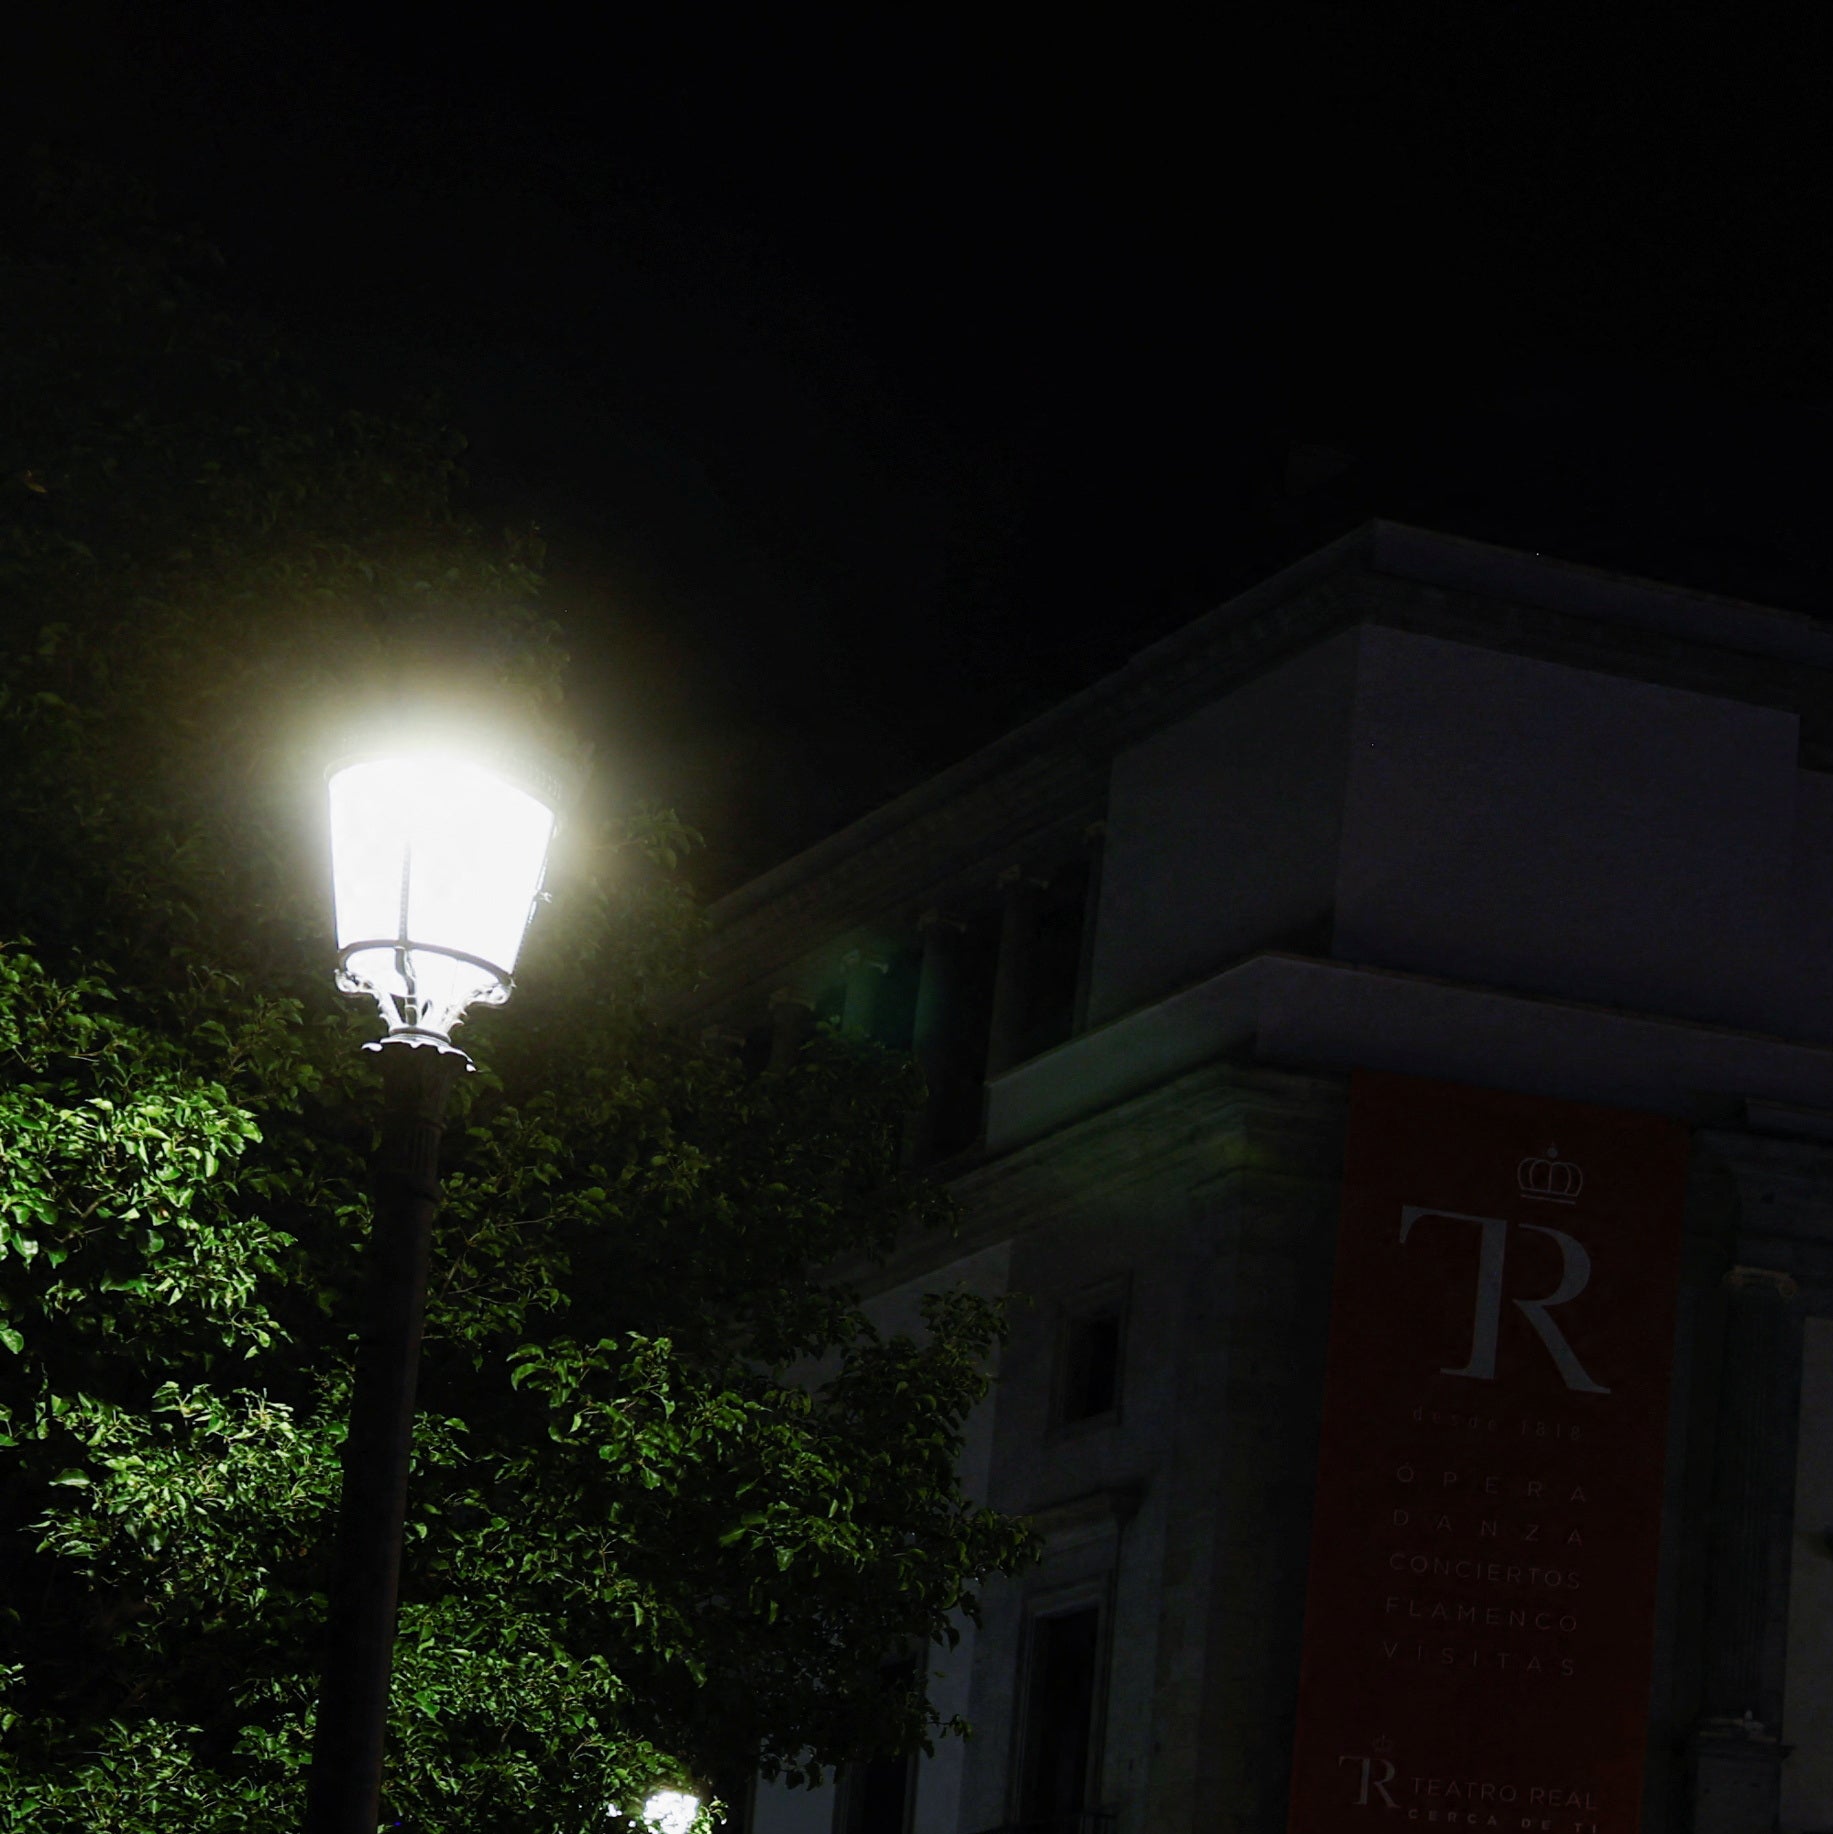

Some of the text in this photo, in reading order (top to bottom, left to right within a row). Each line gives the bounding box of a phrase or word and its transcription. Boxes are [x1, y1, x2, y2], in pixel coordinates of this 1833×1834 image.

[1413, 1405, 1583, 1441] desde 1818
[1397, 1462, 1586, 1503] ÓPERA
[1393, 1509, 1583, 1548] DANZA
[1389, 1552, 1580, 1590] CONCIERTOS
[1386, 1597, 1576, 1632] FLAMENCO
[1383, 1641, 1574, 1677] VISITAS
[1410, 1777, 1598, 1811] TEATRO REAL
[1408, 1808, 1597, 1834] CERCA DE TI
